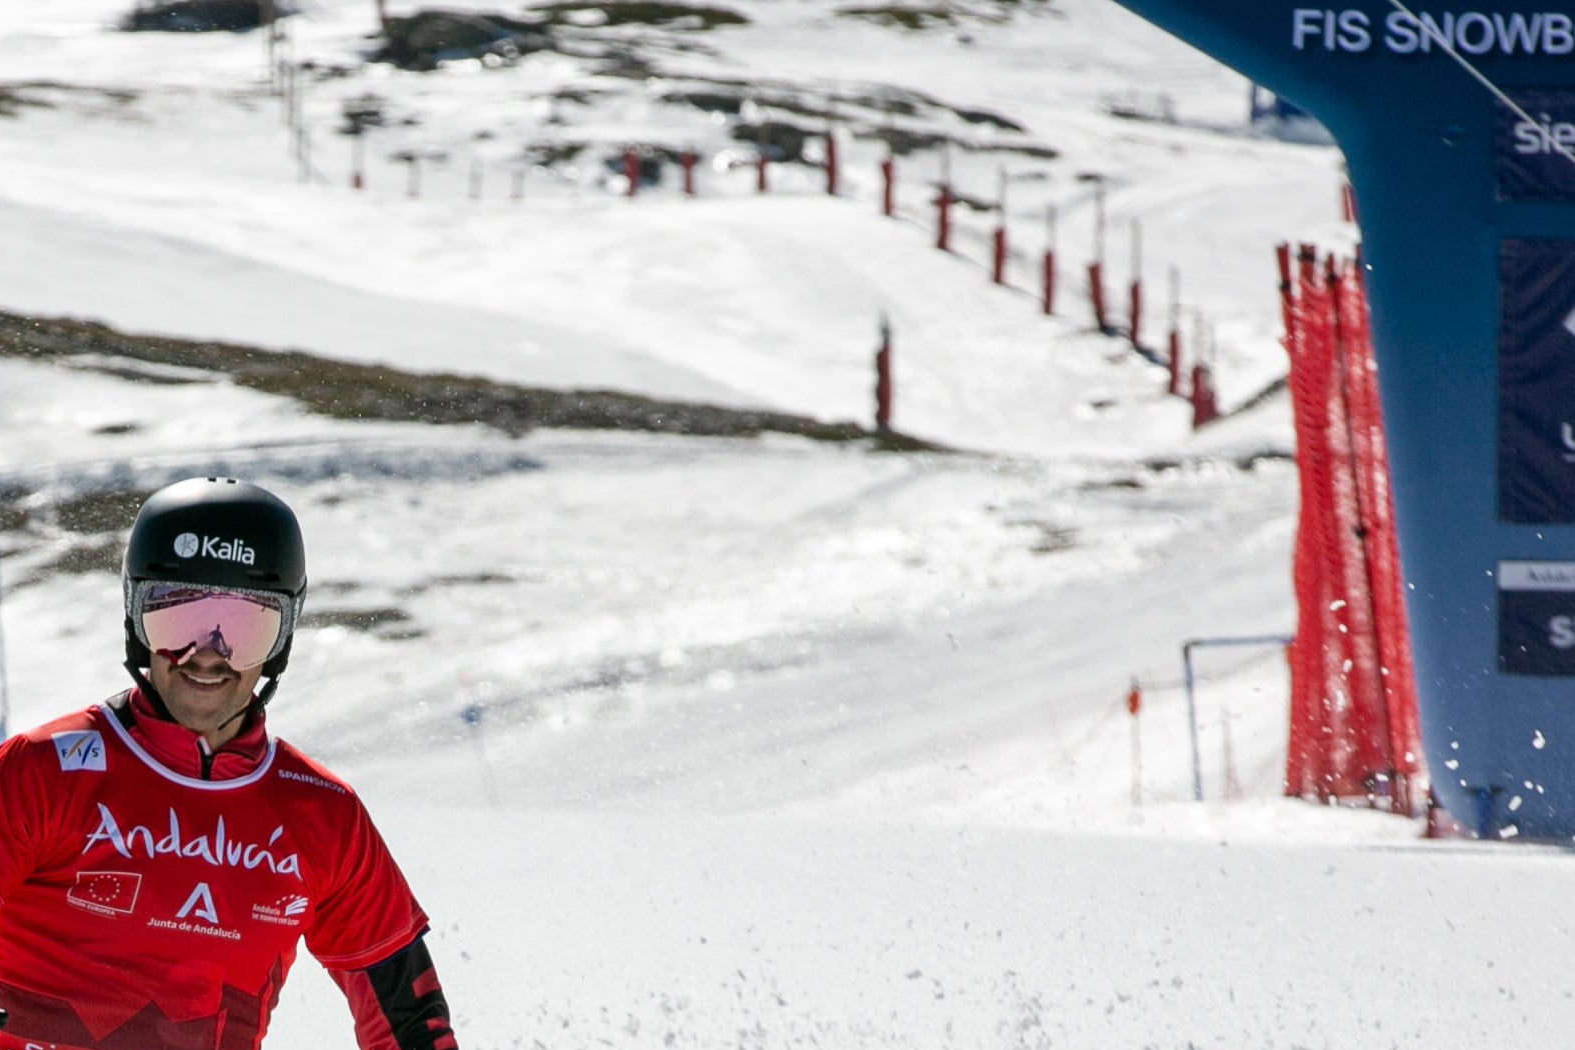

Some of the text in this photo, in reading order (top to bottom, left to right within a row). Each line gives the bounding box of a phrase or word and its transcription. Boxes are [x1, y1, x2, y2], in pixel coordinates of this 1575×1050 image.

[1292, 8, 1372, 51] FIS
[201, 535, 256, 566] Kalia
[278, 769, 346, 795] SPAINSNOW
[81, 802, 303, 882] Andalucía
[147, 917, 241, 941] Junta de Andalucía
